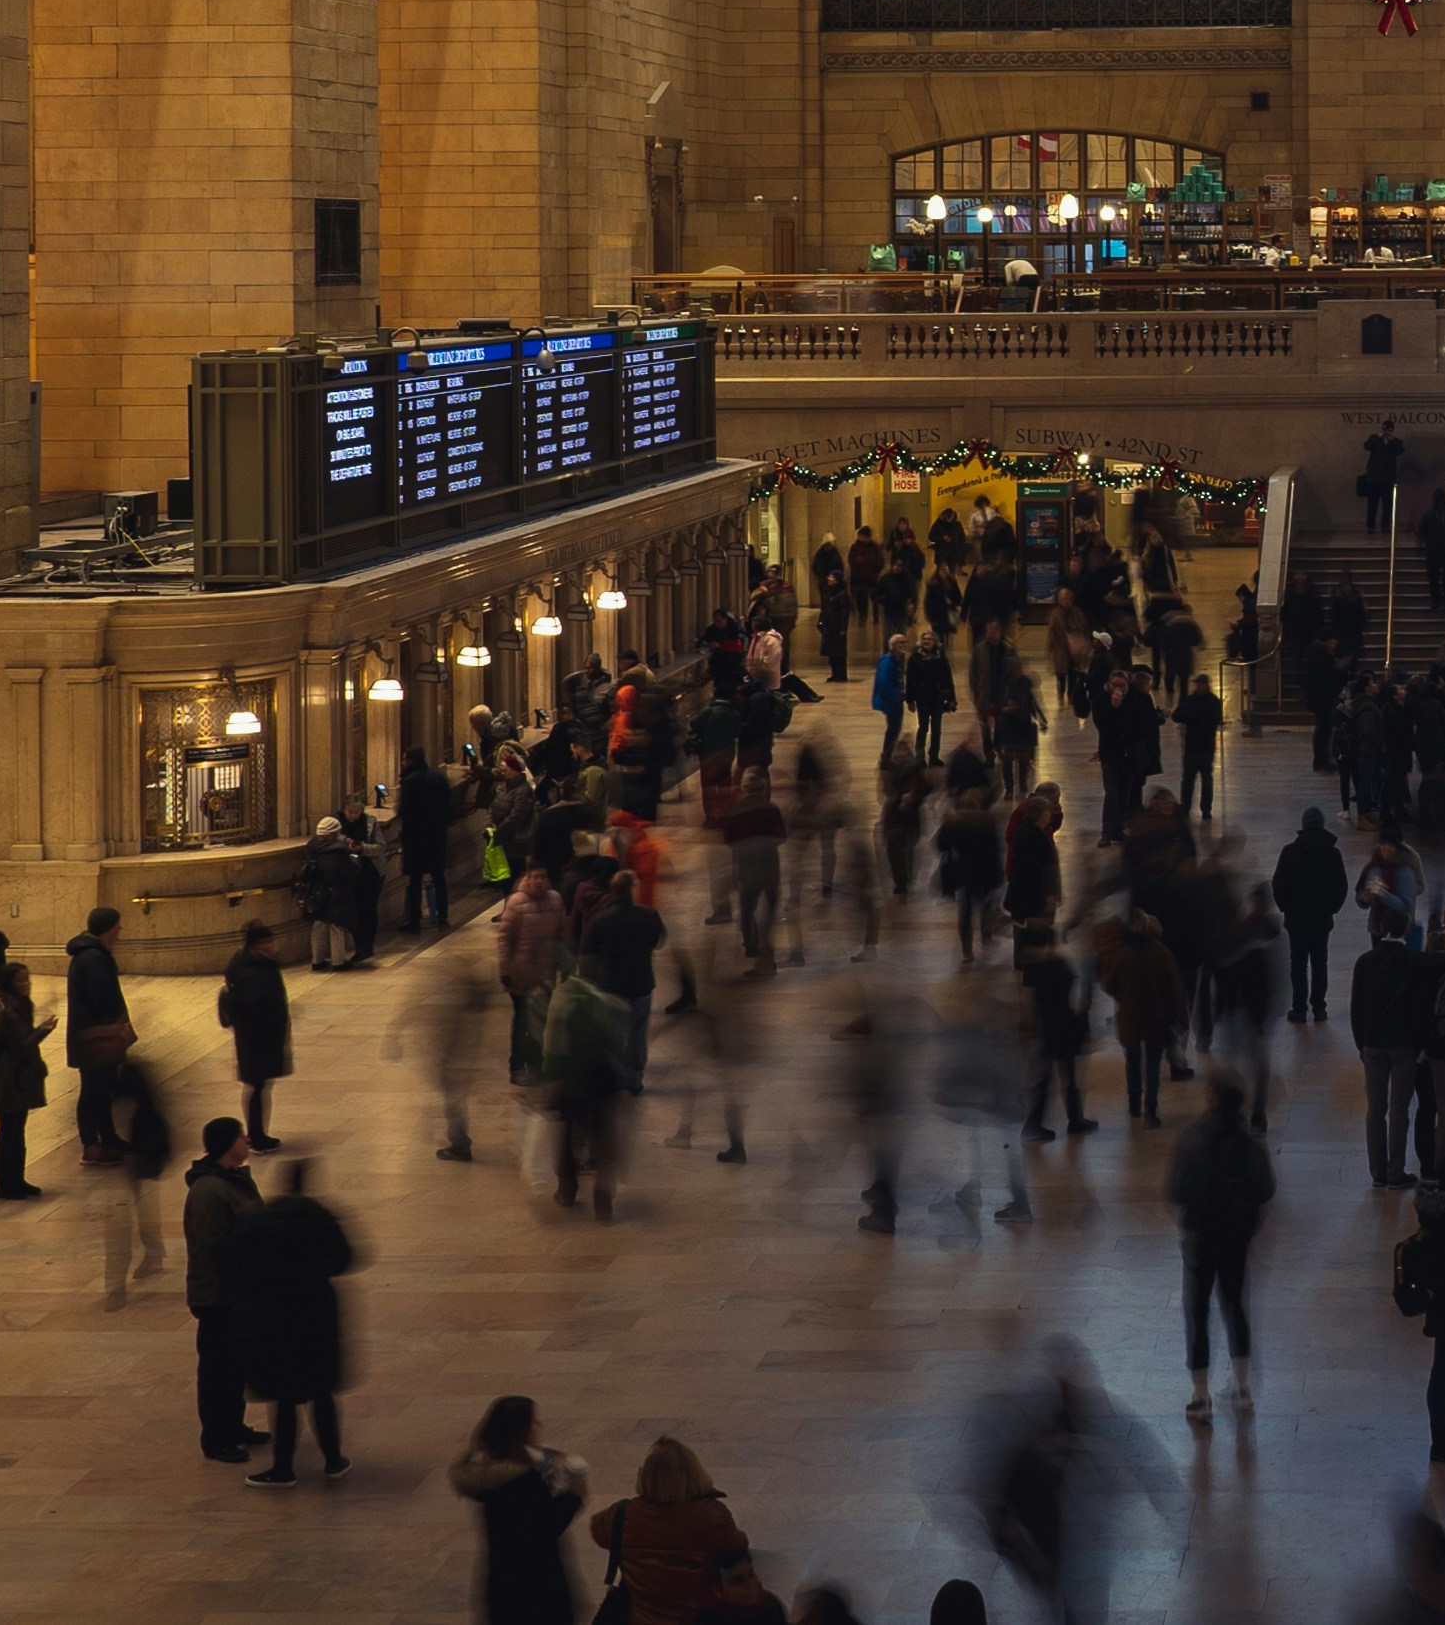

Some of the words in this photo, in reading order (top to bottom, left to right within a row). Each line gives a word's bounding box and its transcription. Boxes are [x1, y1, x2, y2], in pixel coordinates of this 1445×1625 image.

[1341, 412, 1383, 423] WEST
[827, 427, 941, 453] MACHINES
[1015, 428, 1100, 448] SUBWAY
[1118, 438, 1171, 458] 42ND
[1178, 447, 1203, 465] ST
[894, 480, 918, 490] HOSE
